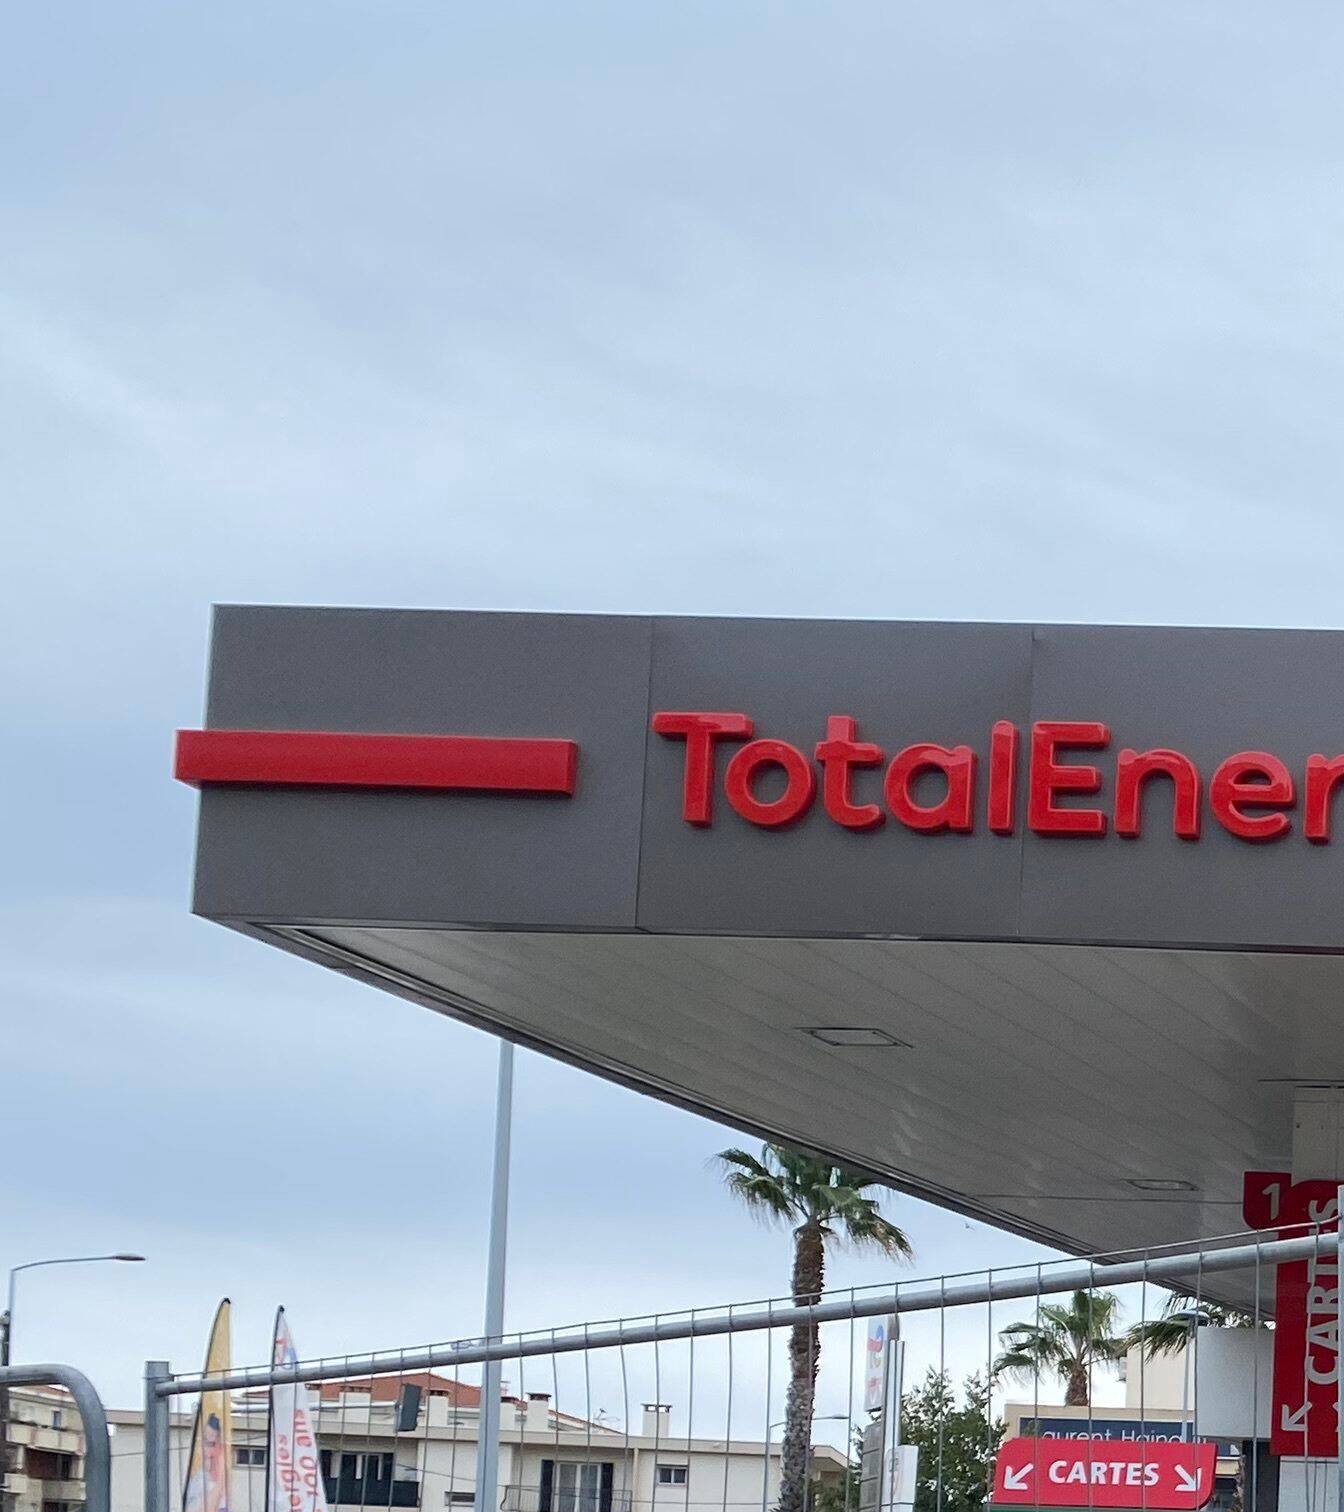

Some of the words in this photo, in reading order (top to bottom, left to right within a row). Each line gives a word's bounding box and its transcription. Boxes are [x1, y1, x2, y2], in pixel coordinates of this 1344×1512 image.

[1261, 1182, 1281, 1221] 1
[1307, 1197, 1339, 1386] CARTS
[1048, 1459, 1160, 1487] CARTES
